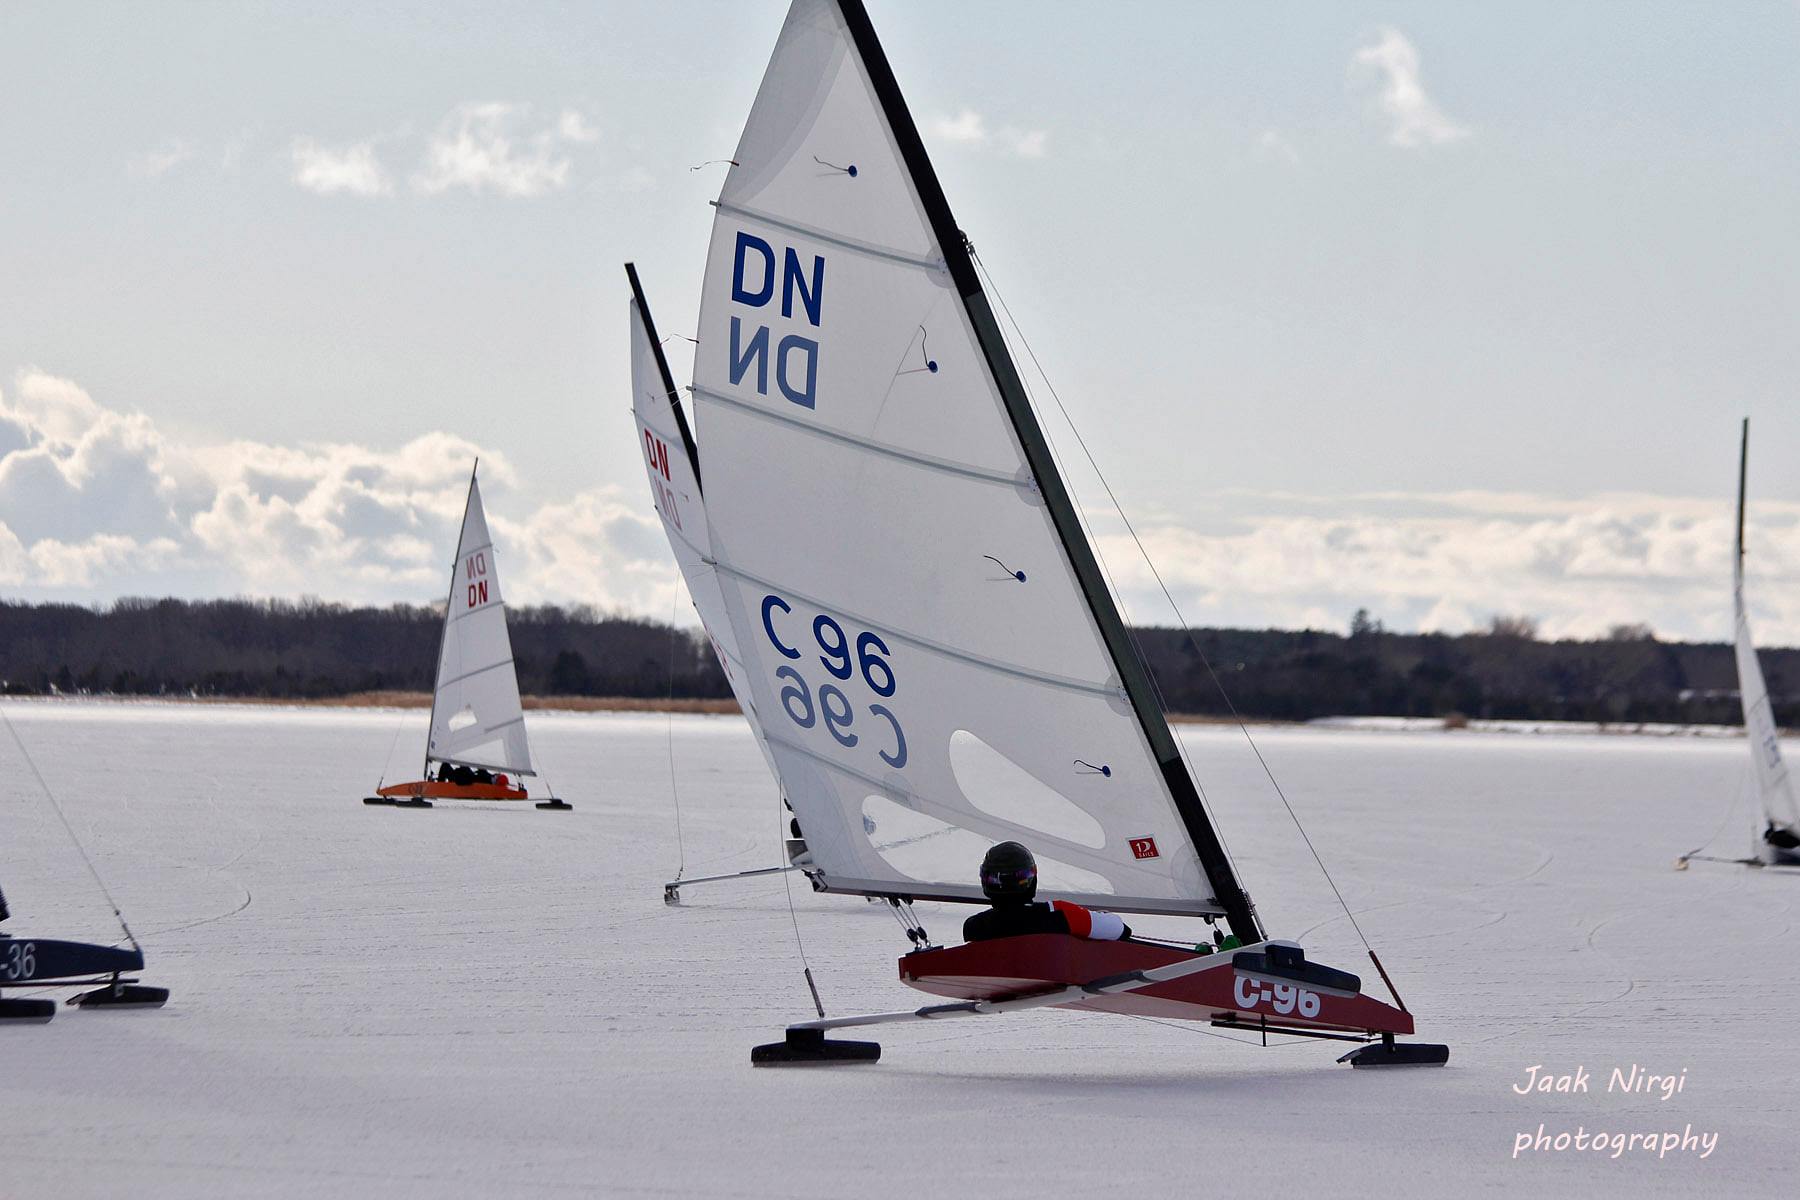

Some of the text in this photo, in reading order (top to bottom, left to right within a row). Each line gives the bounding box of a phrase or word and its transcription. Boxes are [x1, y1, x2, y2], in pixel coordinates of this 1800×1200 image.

[731, 231, 825, 327] DN
[645, 428, 670, 481] DN
[468, 579, 488, 608] DN
[761, 595, 801, 659] C
[812, 614, 896, 699] 96
[1234, 976, 1321, 1018] C-96
